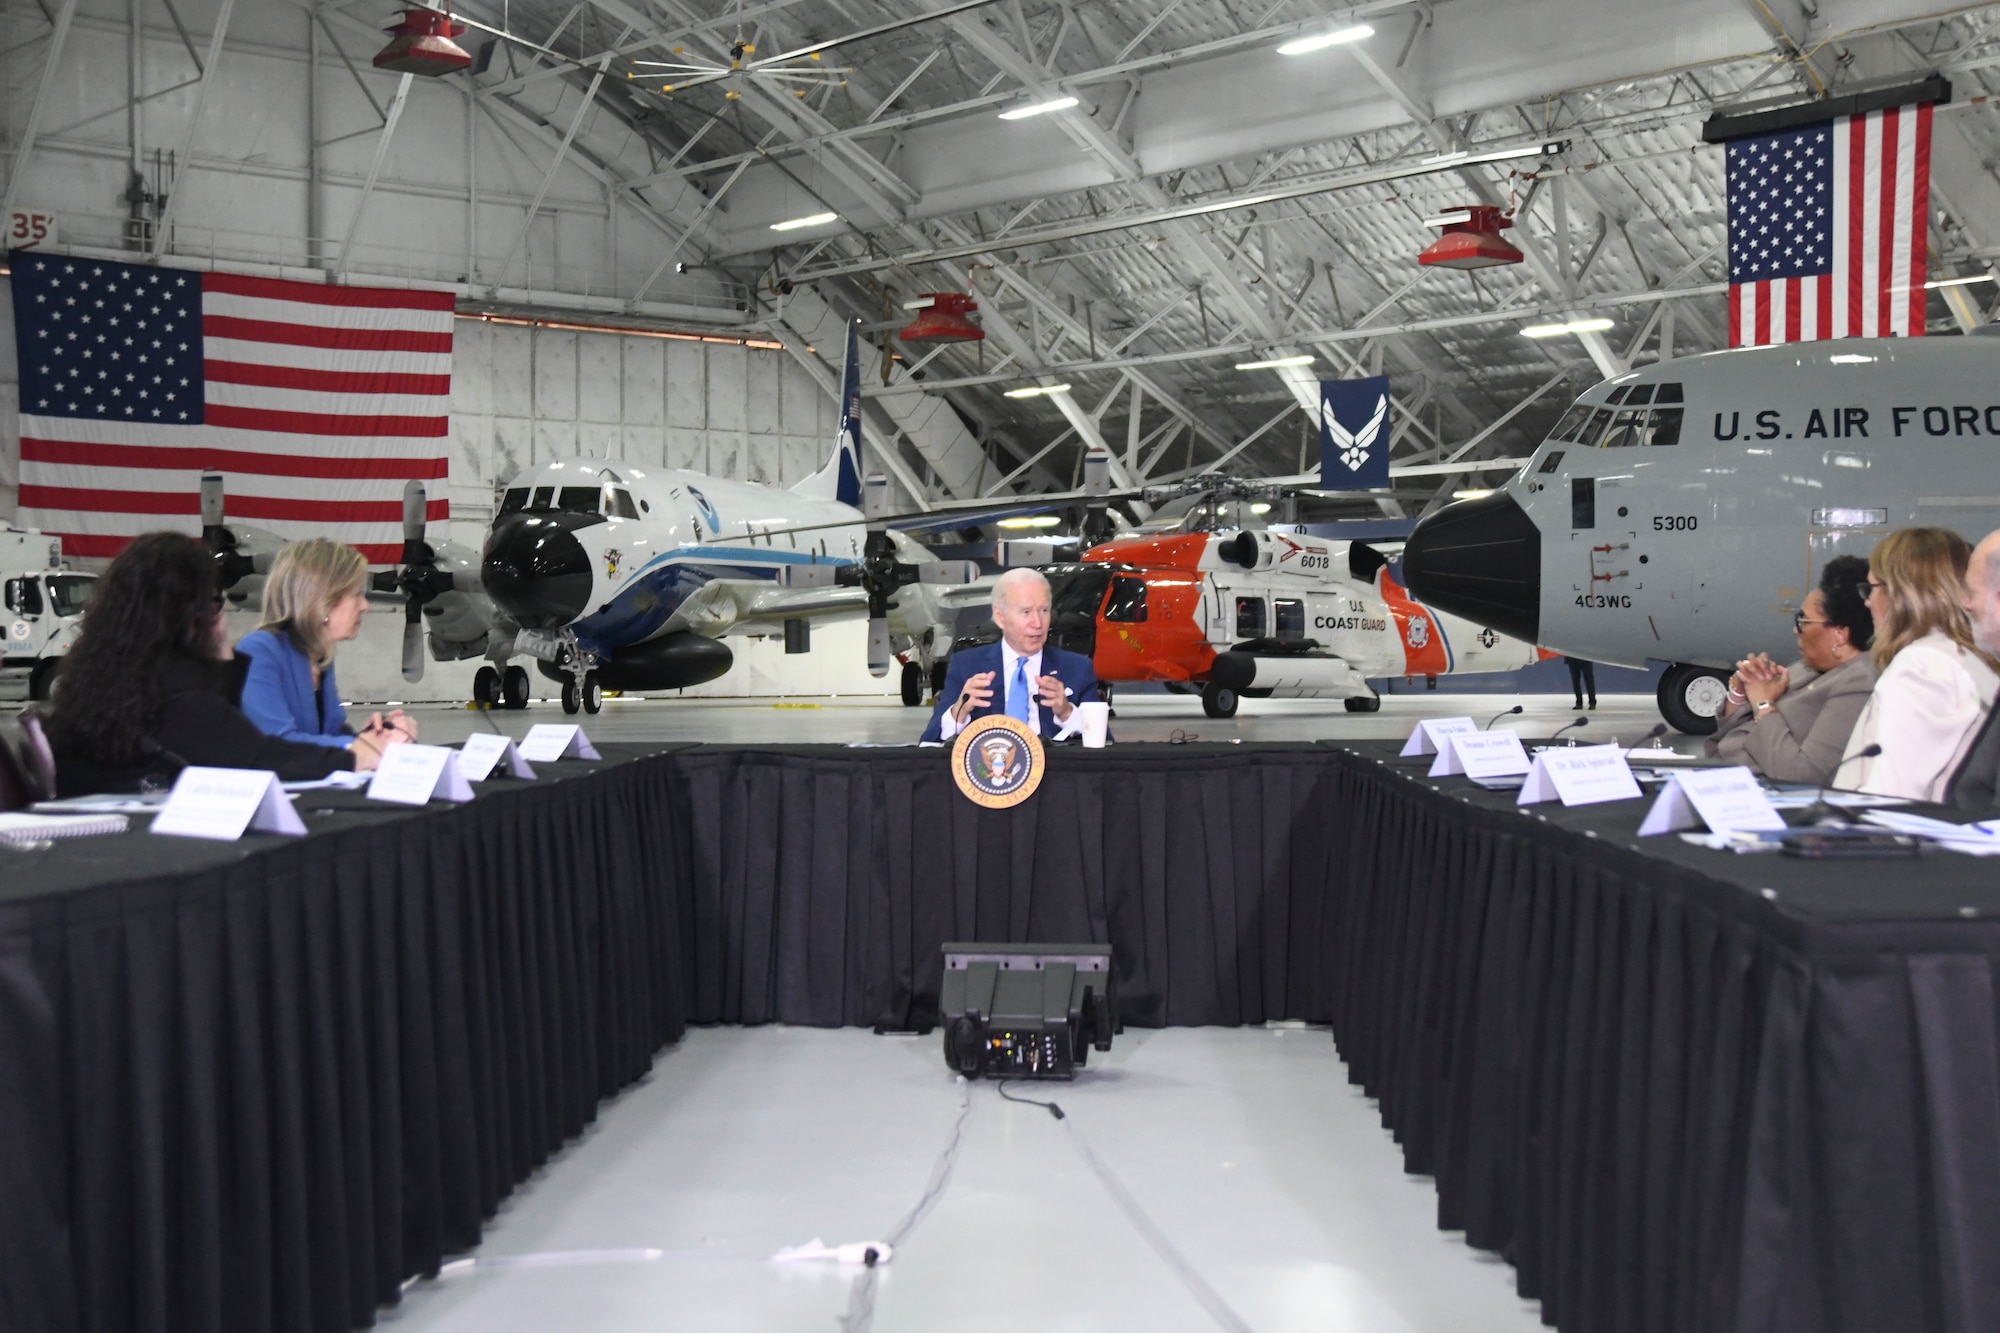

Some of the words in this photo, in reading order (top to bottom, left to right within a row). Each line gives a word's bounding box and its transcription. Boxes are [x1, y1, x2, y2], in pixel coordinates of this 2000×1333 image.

[1714, 410, 1792, 441] U.S.
[1804, 408, 1869, 438] AIR
[1653, 515, 1698, 531] 5300
[1301, 555, 1329, 569] 6018
[1349, 600, 1366, 612] U.S.
[1315, 616, 1359, 629] COAST
[1361, 618, 1386, 631] GUARD
[956, 718, 996, 759] PRESIDENT
[1023, 729, 1041, 768] UNITED
[967, 786, 990, 803] SEAL
[1007, 775, 1038, 803] STATES
